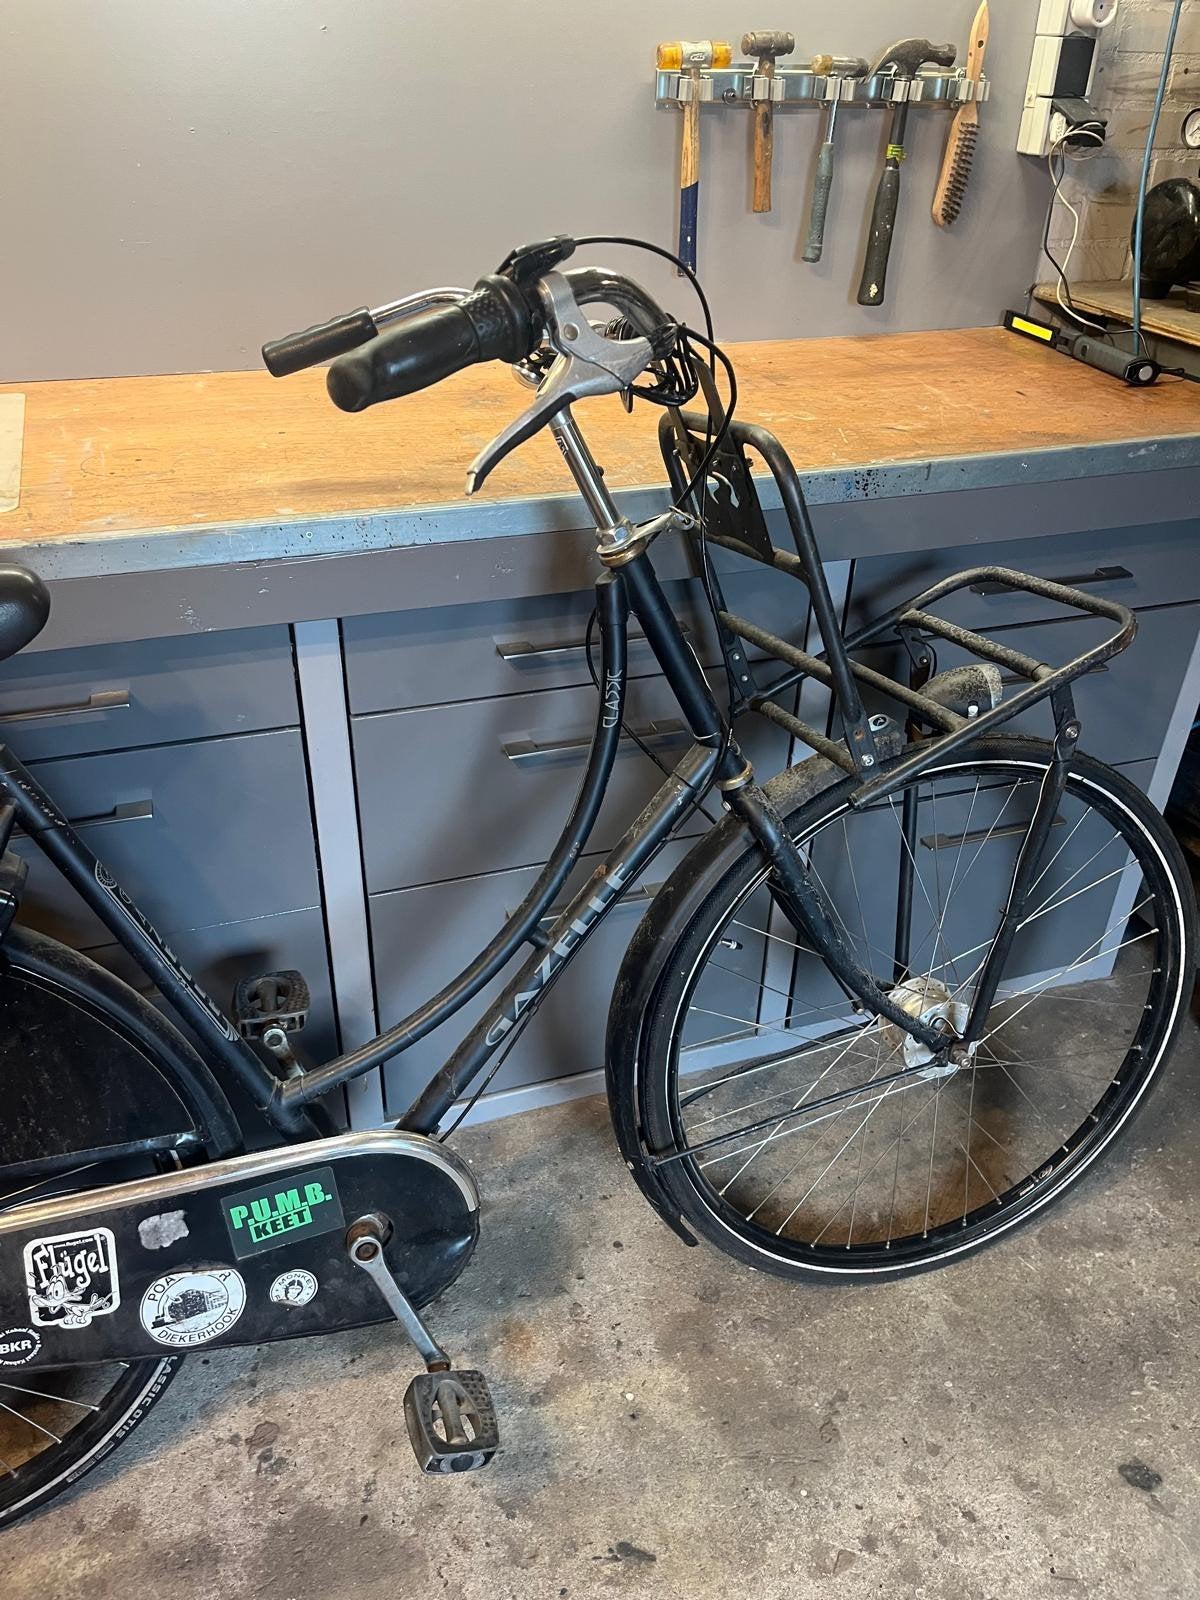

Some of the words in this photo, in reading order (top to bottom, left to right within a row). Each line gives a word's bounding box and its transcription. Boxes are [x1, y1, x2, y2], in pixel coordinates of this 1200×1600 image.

[602, 668, 623, 728] CLASSIC
[485, 862, 634, 1046] GAZELLE
[229, 1182, 333, 1230] P.U.M.B.
[253, 1209, 307, 1240] KEET
[33, 1232, 109, 1289] Flügel
[278, 1273, 314, 1290] MONKEY
[157, 1307, 239, 1343] DIEKERHOOK
[0, 1339, 32, 1355] BKR
